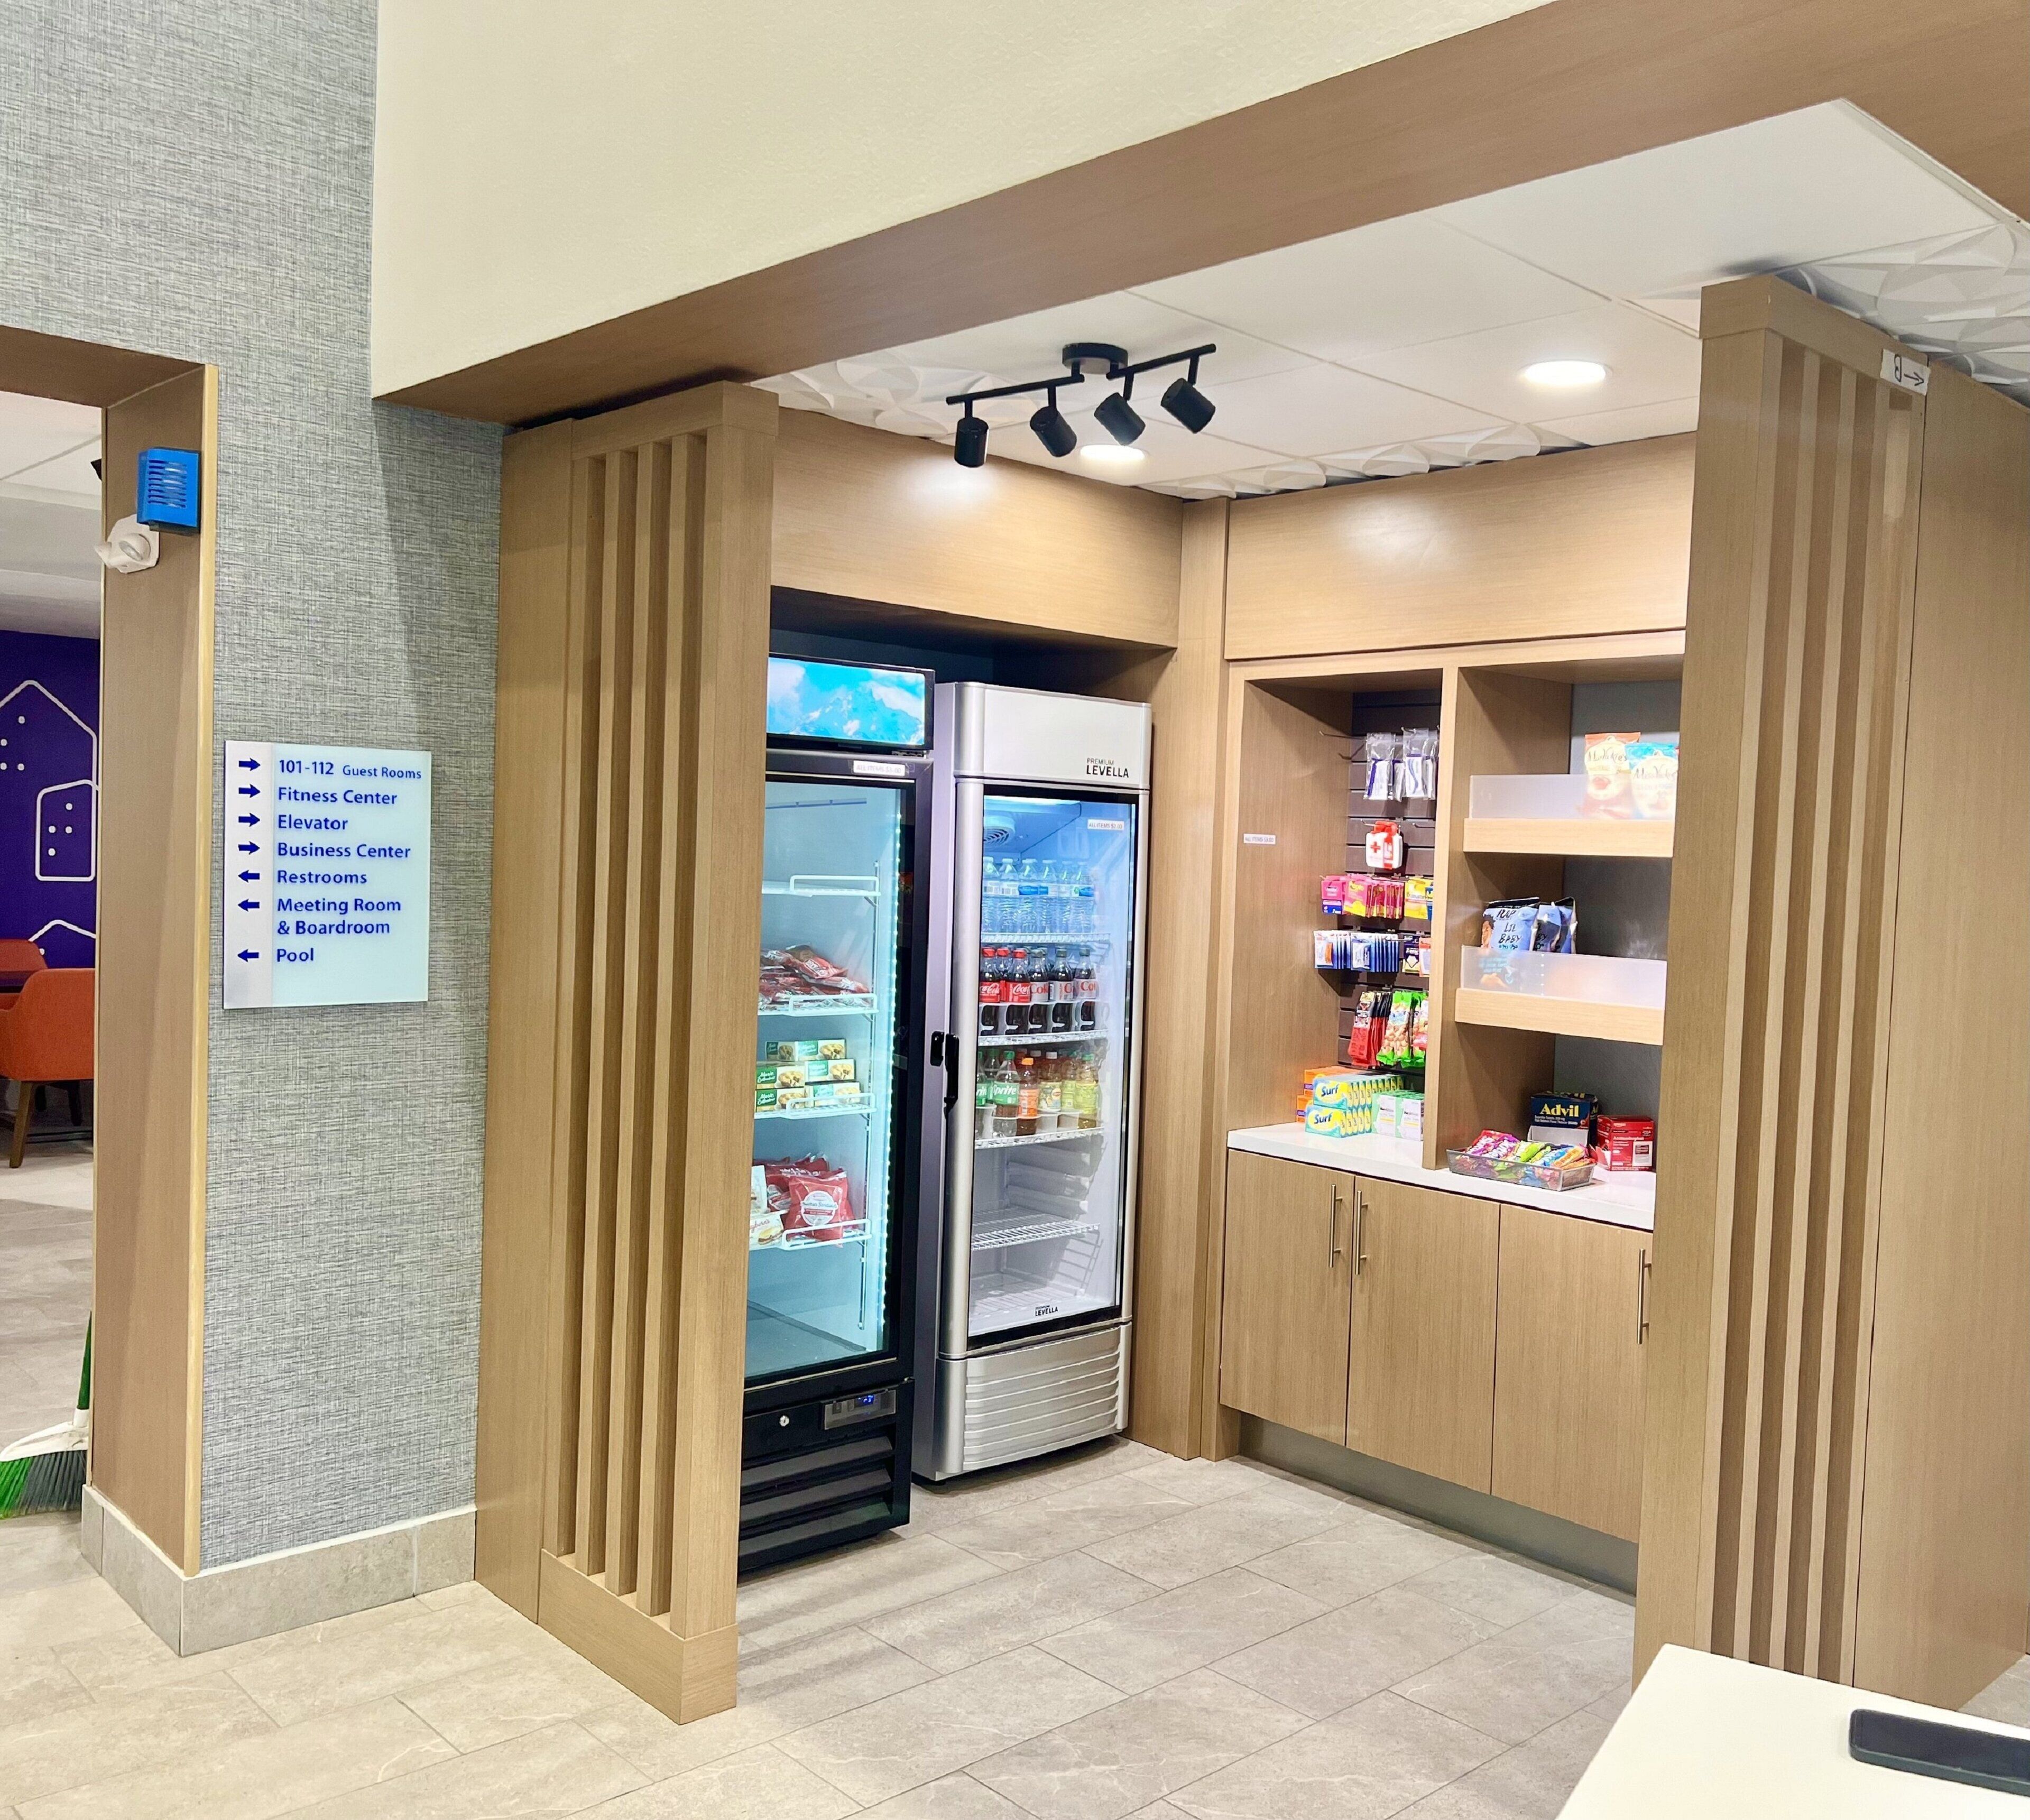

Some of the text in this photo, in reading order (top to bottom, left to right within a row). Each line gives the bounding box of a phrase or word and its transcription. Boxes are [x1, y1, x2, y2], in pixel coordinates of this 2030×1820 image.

[280, 760, 421, 779] 101-112 Guest Rooms
[1086, 765, 1129, 778] LEVELLA
[279, 787, 397, 804] Fitness Center
[279, 815, 348, 829] Elevator
[278, 843, 410, 858] Business Center
[278, 870, 367, 884] Restrooms
[278, 898, 401, 914] Meeting Room
[1497, 909, 1516, 919] RAP
[278, 920, 389, 935] & Boardroom
[1498, 933, 1522, 944] BABY
[277, 948, 313, 962] Pool
[1031, 983, 1048, 994] Cok
[993, 1084, 1017, 1096] Sprite
[1321, 1084, 1339, 1097] Surf
[1539, 1103, 1579, 1117] Advil
[1314, 1111, 1333, 1124] Surf
[1035, 1306, 1058, 1316] LEVELLA
